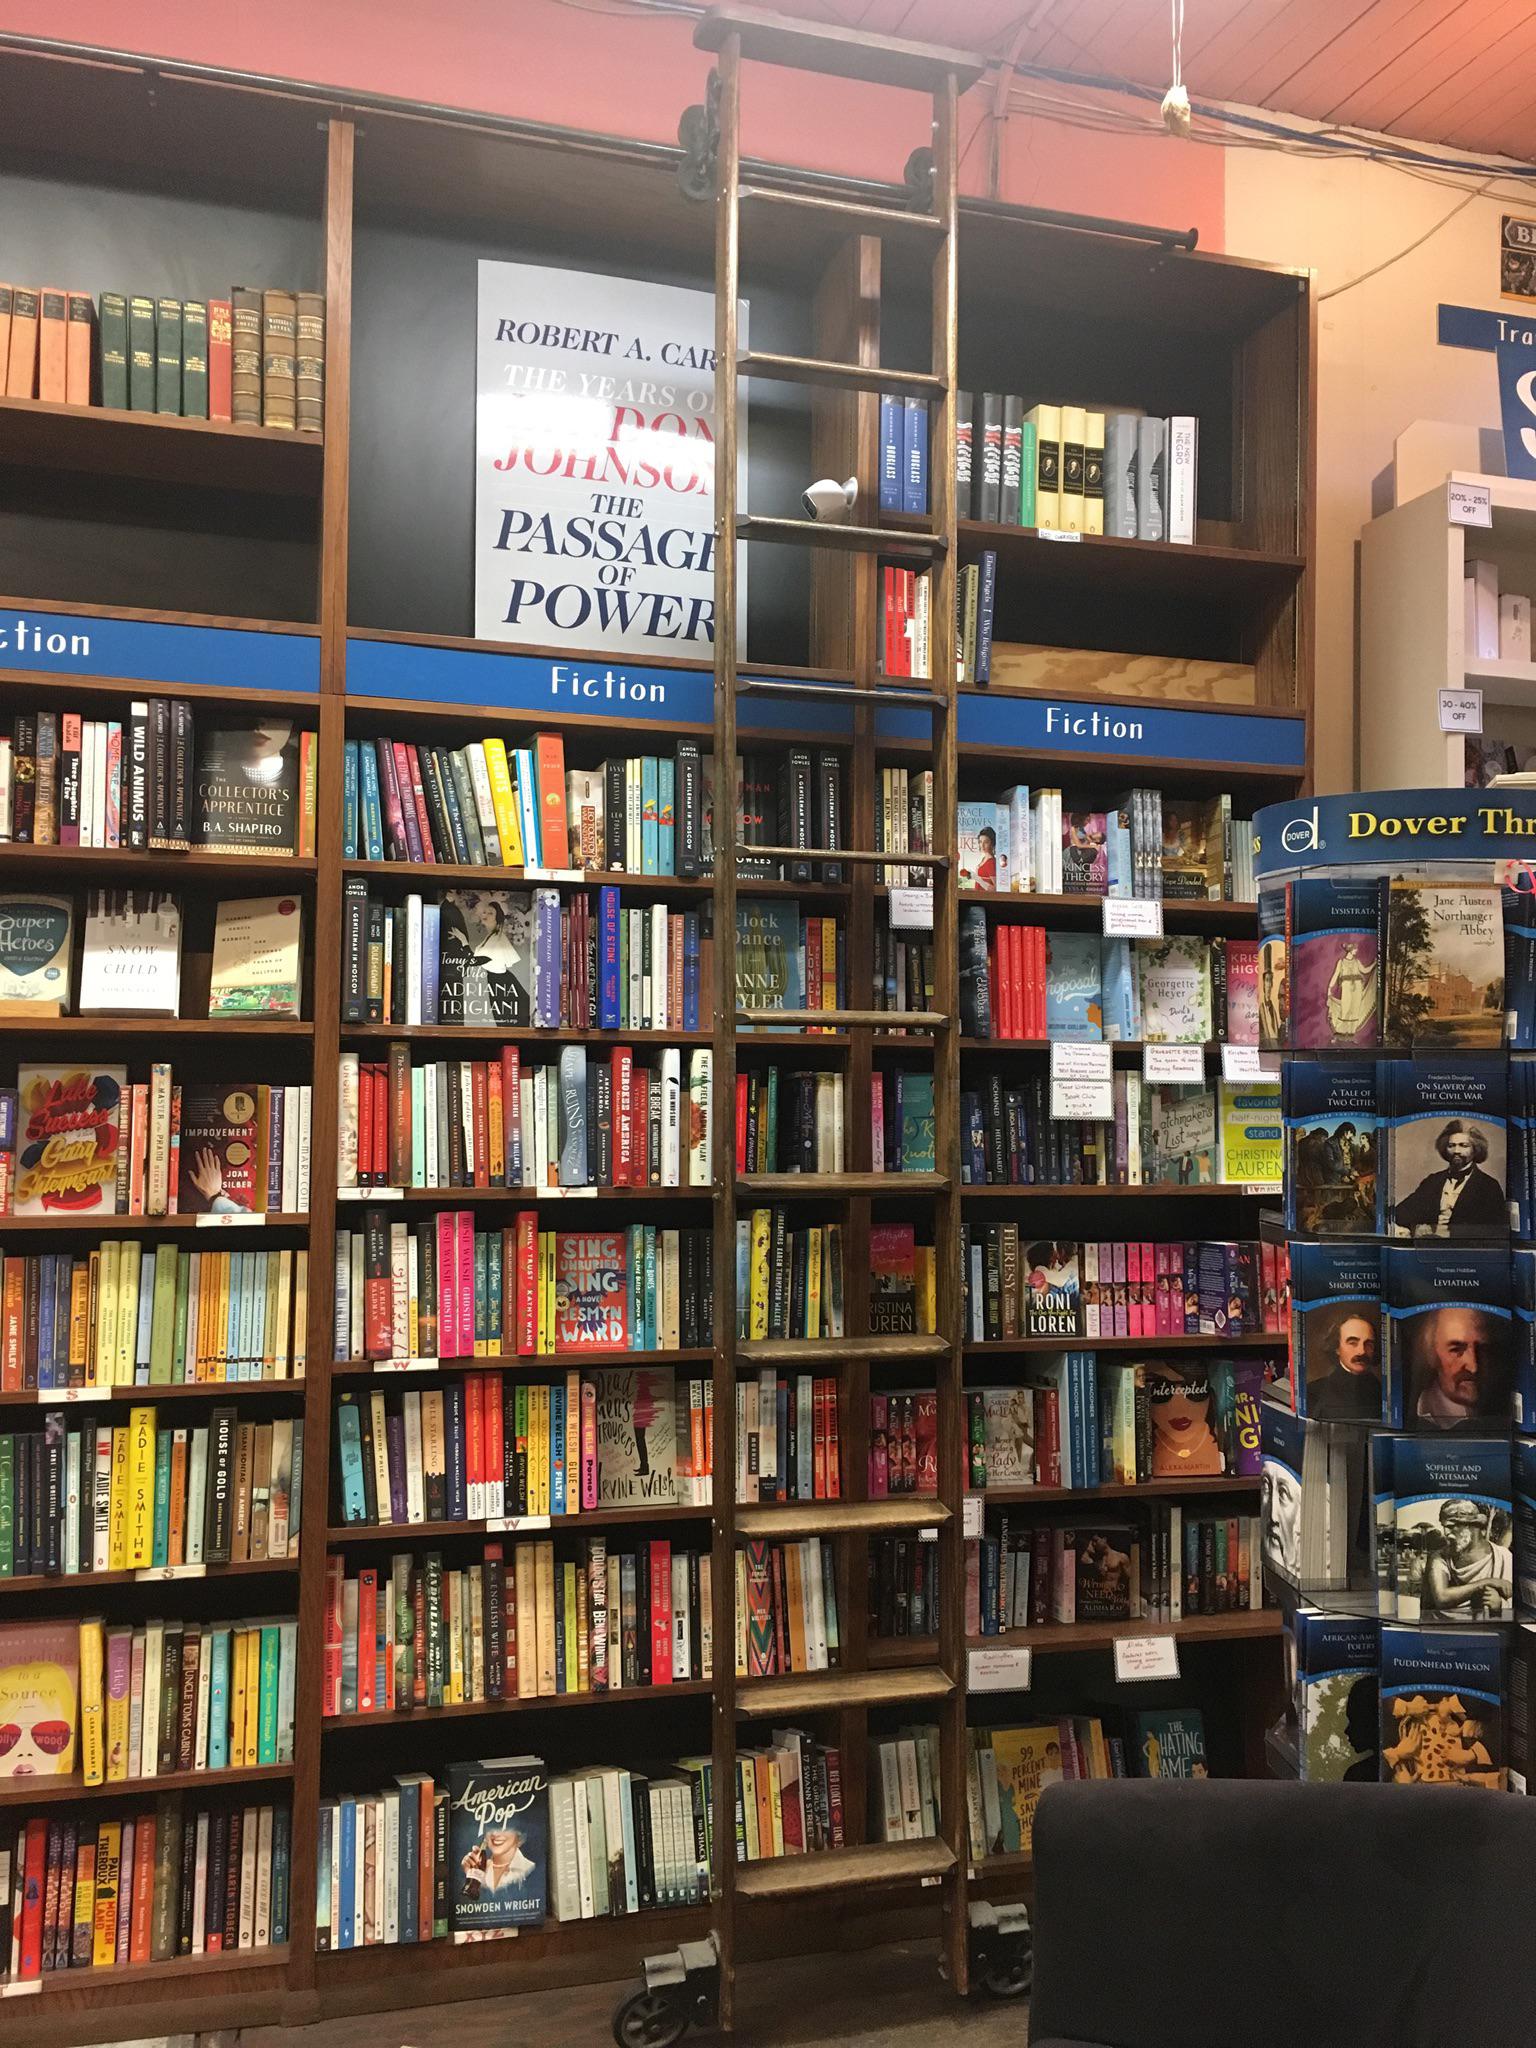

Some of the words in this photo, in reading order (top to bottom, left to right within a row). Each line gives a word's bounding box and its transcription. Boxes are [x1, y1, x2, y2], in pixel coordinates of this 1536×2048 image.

[495, 318, 618, 355] ROBERT
[625, 337, 652, 361] A.
[661, 342, 716, 371] CAR
[503, 363, 567, 392] THE
[578, 372, 676, 408] YEARS
[590, 493, 643, 518] THE
[1451, 493, 1467, 502] 20%
[1473, 496, 1488, 505] 25%
[1462, 505, 1477, 514] OFF
[493, 509, 716, 573] PASSAGE
[598, 564, 636, 587] OF
[501, 578, 716, 643] POWER
[551, 666, 666, 703] Fiction
[1442, 700, 1453, 708] 30
[1460, 701, 1477, 709] 40%
[1046, 707, 1144, 740] Fiction
[1452, 712, 1466, 720] OFF
[133, 725, 146, 761] WILD
[71, 758, 79, 779] Three
[69, 781, 78, 820] Daughters
[132, 765, 145, 822] ANIMUS
[199, 783, 290, 801] COLLECTOR'S
[201, 799, 285, 817] APPRENTICE
[228, 822, 282, 836] SHAPIRO
[455, 823, 464, 848] Master
[1286, 830, 1310, 841] DOVER
[1348, 811, 1467, 838] Dover
[606, 891, 616, 919] HOUSE
[1331, 906, 1376, 916] LYSISTRATA
[1433, 895, 1455, 907] Jane
[1459, 895, 1493, 906] Austen
[0, 912, 55, 937] Super
[607, 922, 616, 932] OF
[1433, 909, 1494, 924] Northanger
[0, 930, 55, 952] Heroes
[1459, 926, 1494, 941] Abbey
[106, 945, 157, 956] SNOW
[441, 951, 476, 967] Tony's
[606, 935, 616, 963] STONE
[104, 964, 157, 976] CHILD
[460, 966, 486, 979] Wife
[441, 982, 519, 997] ADRIANA
[1147, 978, 1195, 990] Georgette
[1157, 987, 1186, 999] Heyer
[441, 1000, 519, 1016] TRIGIANI
[621, 1057, 630, 1111] CHEROKEE
[1341, 1088, 1362, 1098] TALE
[1416, 1083, 1427, 1091] ON
[1429, 1082, 1465, 1091] SLAVERY
[1466, 1083, 1486, 1091] AND
[1237, 1096, 1278, 1107] favorite
[1327, 1097, 1345, 1107] TWO
[1347, 1097, 1376, 1107] CITIES
[1420, 1092, 1436, 1100] THE
[1439, 1092, 1462, 1100] CIVIL
[1464, 1092, 1483, 1101] WAR
[566, 1089, 584, 1128] RUINS
[650, 1096, 661, 1120] BREAK
[1231, 1112, 1280, 1123] half-night
[184, 1127, 254, 1138] IMPROVEMENT
[621, 1114, 631, 1163] AMERICA
[1164, 1129, 1187, 1150] List
[1248, 1127, 1278, 1139] stand
[226, 1170, 249, 1179] JOAN
[1227, 1161, 1283, 1176] LAUREN
[222, 1180, 252, 1189] SILBER
[220, 1214, 232, 1224] S
[562, 1237, 621, 1262] SING,
[647, 1233, 655, 1260] SALVAGE
[1004, 1229, 1015, 1291] HERESY
[566, 1272, 619, 1293] SING
[1328, 1281, 1352, 1289] SHORT
[1339, 1272, 1378, 1280] SELECTED
[1433, 1279, 1480, 1287] LEVIATHAN
[443, 1287, 452, 1332] GHOSTED
[462, 1286, 471, 1330] GHOSTED
[1035, 1292, 1071, 1310] RONI
[560, 1306, 622, 1321] JESMYN
[1030, 1313, 1076, 1333] LOREN
[9, 1315, 17, 1336] JANE
[561, 1321, 623, 1342] WARD
[8, 1338, 17, 1369] SMILEY
[1149, 1379, 1208, 1397] Intercepted
[137, 1414, 148, 1473] ZADIE
[218, 1419, 229, 1455] HOUSE
[430, 1423, 438, 1467] STARLING
[693, 1415, 702, 1470] Trainspotting
[116, 1433, 126, 1485] ZADIE
[1184, 1462, 1211, 1471] MARTIN
[1425, 1464, 1461, 1474] SOPHIST
[1463, 1464, 1483, 1473] AND
[569, 1461, 577, 1484] GLUE
[1429, 1472, 1478, 1482] STATESMAN
[96, 1471, 110, 1497] ZADIE
[216, 1470, 226, 1499] GOLD
[555, 1471, 563, 1499] FILTH
[95, 1500, 109, 1532] SMITH
[113, 1499, 125, 1552] SMITH
[133, 1488, 147, 1549] SMITH
[429, 1561, 438, 1638] LANDFALLS
[490, 1584, 498, 1628] ENGLISH
[491, 1632, 499, 1656] WIFE
[1393, 1658, 1452, 1671] PUDD'NHEAD
[1455, 1662, 1491, 1673] WILSON
[111, 1669, 124, 1694] Help
[183, 1670, 195, 1700] UNCLE
[0, 1686, 57, 1700] Source
[182, 1701, 193, 1727] TOM'S
[1168, 1721, 1184, 1732] THE
[36, 1735, 63, 1745] wood
[181, 1728, 193, 1757] CABIN
[1160, 1730, 1203, 1757] HATING
[1020, 1746, 1034, 1761] 99
[1011, 1757, 1046, 1779] PERCENT
[450, 1773, 548, 1808] American
[803, 1765, 811, 1800] SWANN
[1018, 1775, 1042, 1790] MINE
[474, 1795, 535, 1837] Pop
[806, 1804, 814, 1839] STREET
[697, 1831, 705, 1859] SHACK
[97, 1835, 109, 1886] THEROUX
[108, 1856, 118, 1883] PAUL
[95, 1901, 105, 1930] LAND
[455, 1901, 501, 1915] SNOWDEN
[504, 1898, 541, 1912] WRIGHT
[104, 1901, 115, 1945] MOTHER
[226, 1902, 235, 1945] TIDBECK
[119, 1924, 129, 1950] THIEN
